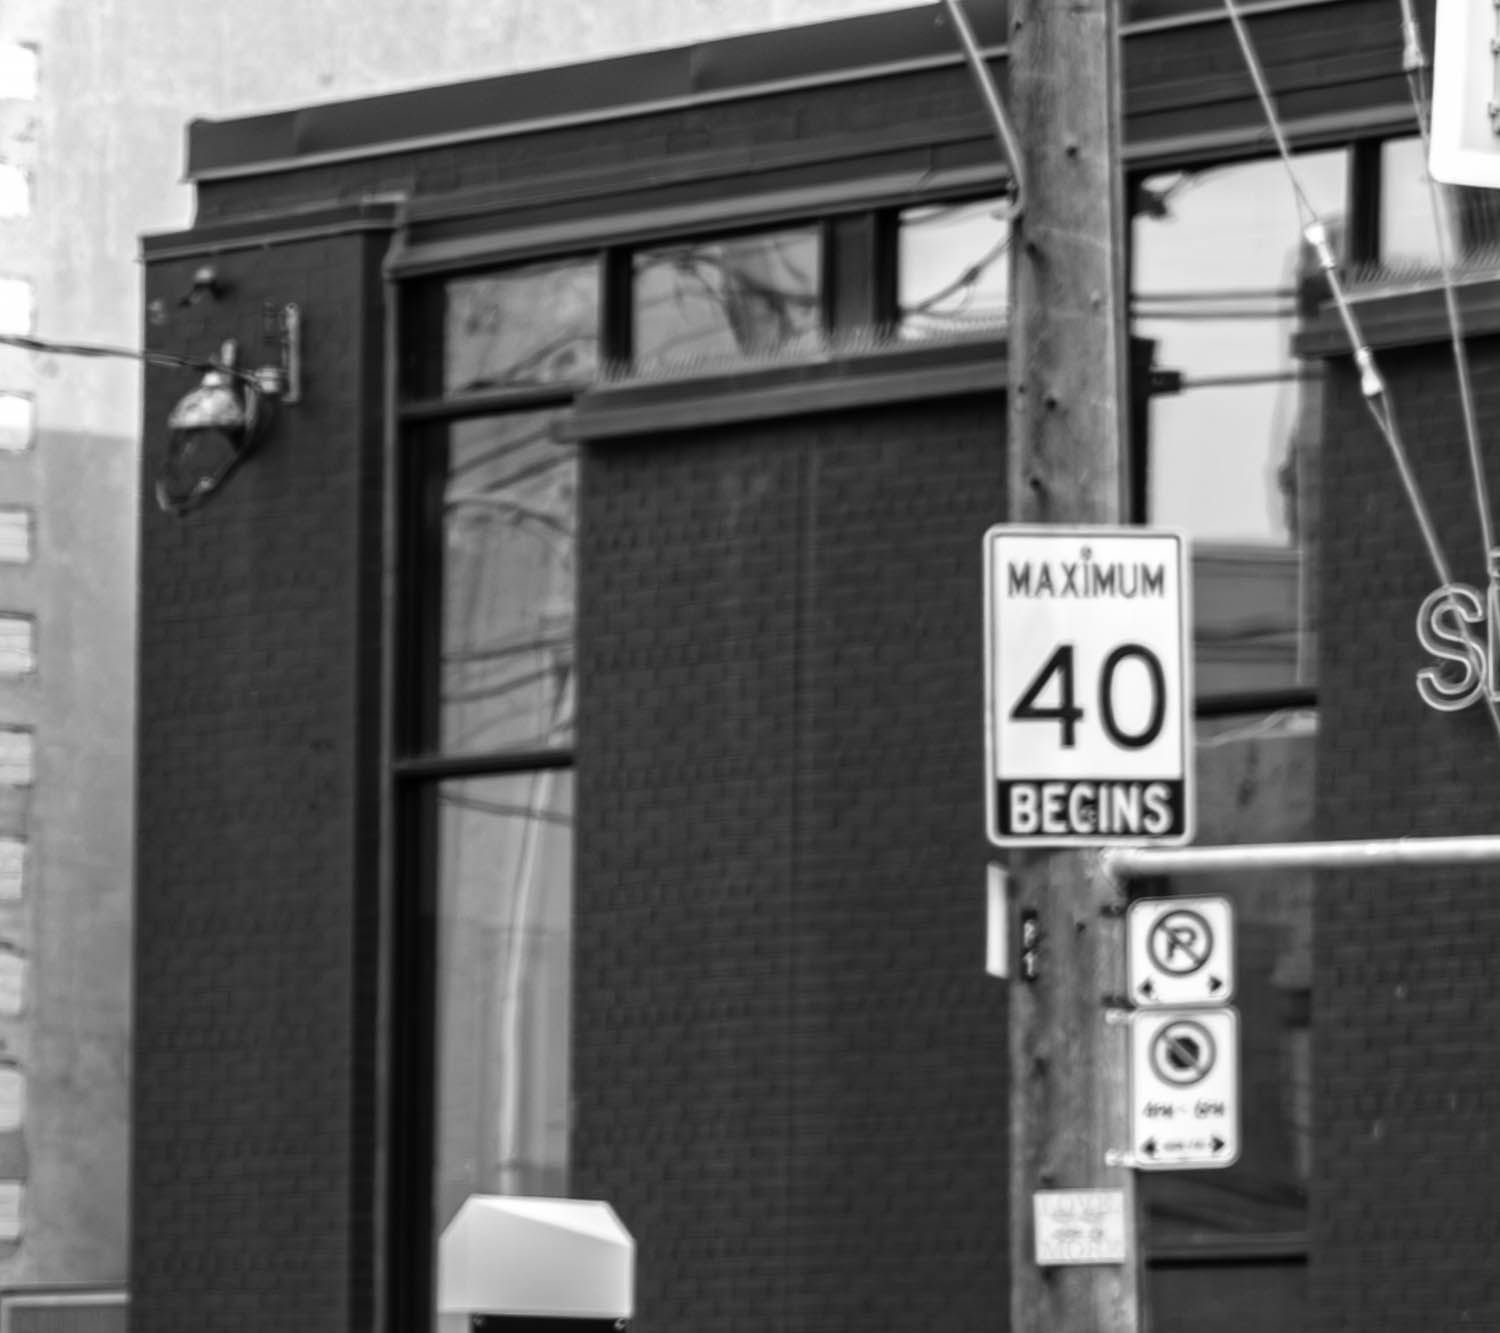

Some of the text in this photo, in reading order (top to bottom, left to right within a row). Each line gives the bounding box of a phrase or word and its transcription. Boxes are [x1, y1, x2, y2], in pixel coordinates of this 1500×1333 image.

[1007, 562, 1166, 598] MAXIMUM
[1009, 643, 1166, 751] 40
[1009, 783, 1172, 833] BEGINS
